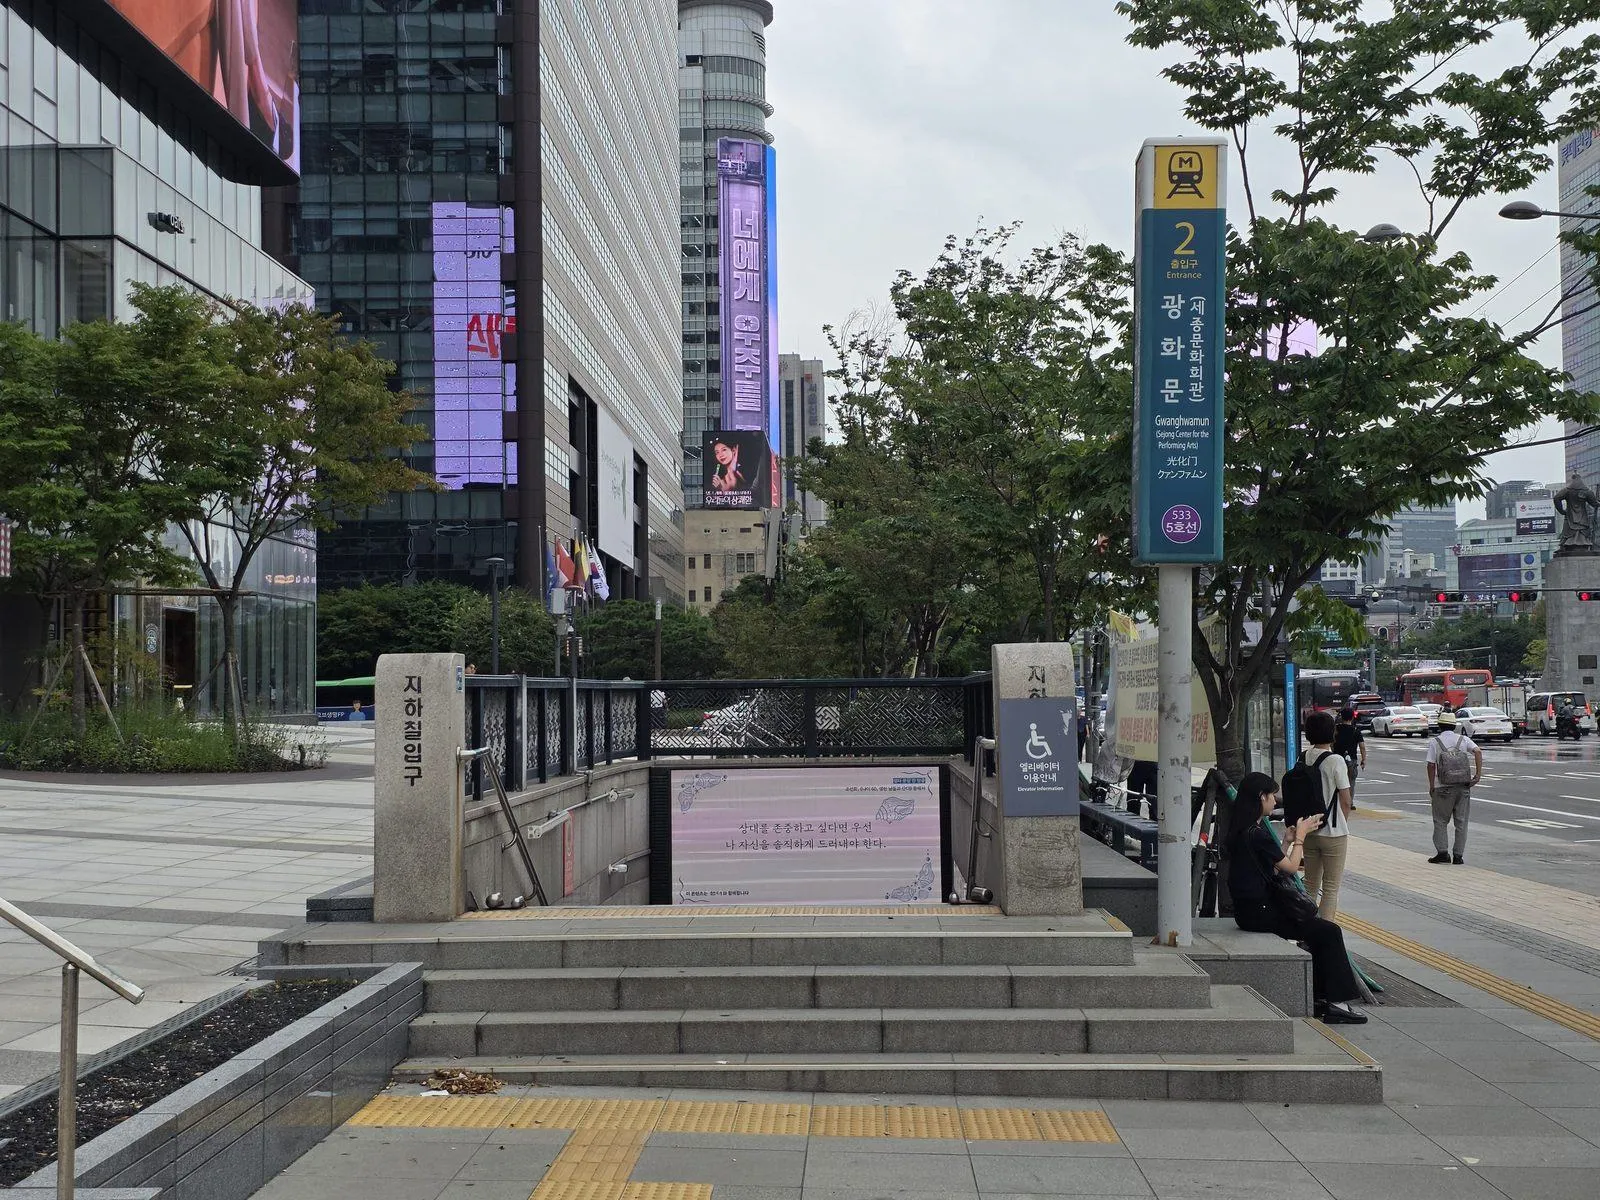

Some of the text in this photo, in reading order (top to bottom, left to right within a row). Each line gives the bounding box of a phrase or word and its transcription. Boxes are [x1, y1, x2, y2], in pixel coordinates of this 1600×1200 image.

[1178, 156, 1193, 168] M
[1173, 221, 1195, 255] 2
[732, 208, 760, 302] 너에게
[1170, 259, 1198, 269] 출입구
[1166, 271, 1202, 279] Entrance
[1160, 294, 1186, 404] 광화문
[1188, 296, 1206, 402] (세종문화회관)
[734, 314, 762, 412] 우주를
[1154, 414, 1210, 429] Gwanghwamun
[1155, 430, 1175, 440] (Sejong
[1176, 430, 1192, 438] Center
[1200, 430, 1209, 438] the
[1158, 441, 1199, 451] Performing Arts)
[1166, 455, 1198, 467] 光化门
[1172, 510, 1191, 520] 533
[1166, 521, 1197, 534] 5호선
[1020, 761, 1060, 772] 엘리베이터
[1023, 773, 1057, 783] 이용안내
[738, 822, 872, 834] 상대를 존중하고 싶다면 우선
[725, 838, 887, 851] 나 자신을 솔직하게 드러내야 한다.
